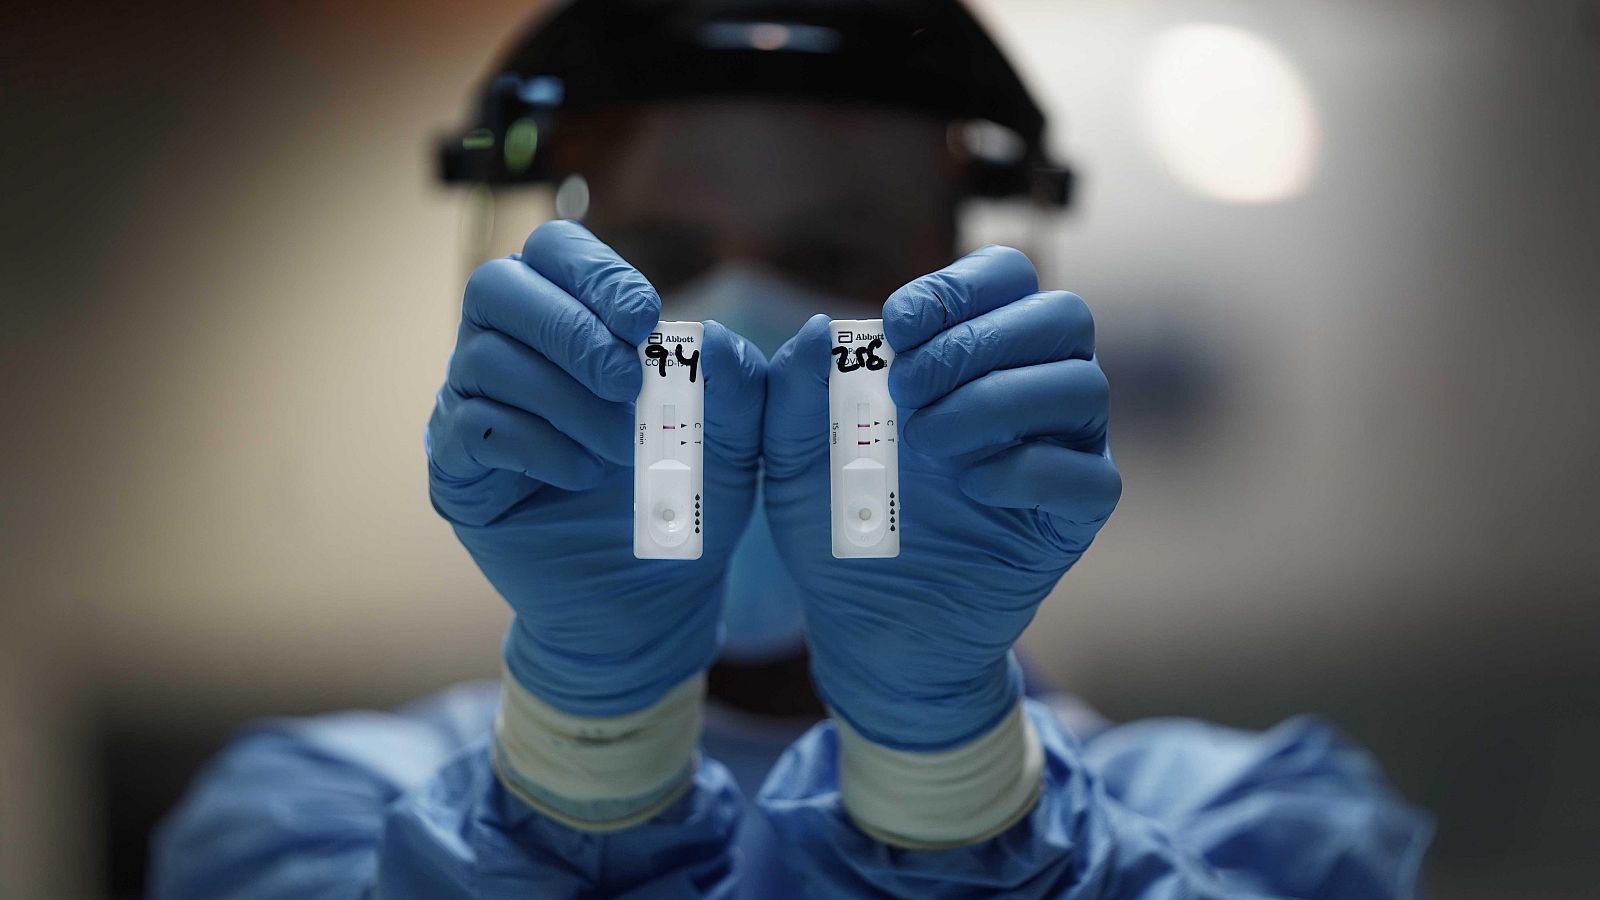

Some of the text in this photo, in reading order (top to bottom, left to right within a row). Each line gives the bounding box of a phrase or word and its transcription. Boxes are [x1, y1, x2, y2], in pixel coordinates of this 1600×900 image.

[665, 335, 694, 343] Abbott
[855, 333, 885, 341] Abbott
[645, 343, 699, 383] 94
[832, 422, 839, 431] 15
[639, 422, 647, 445] 15 min
